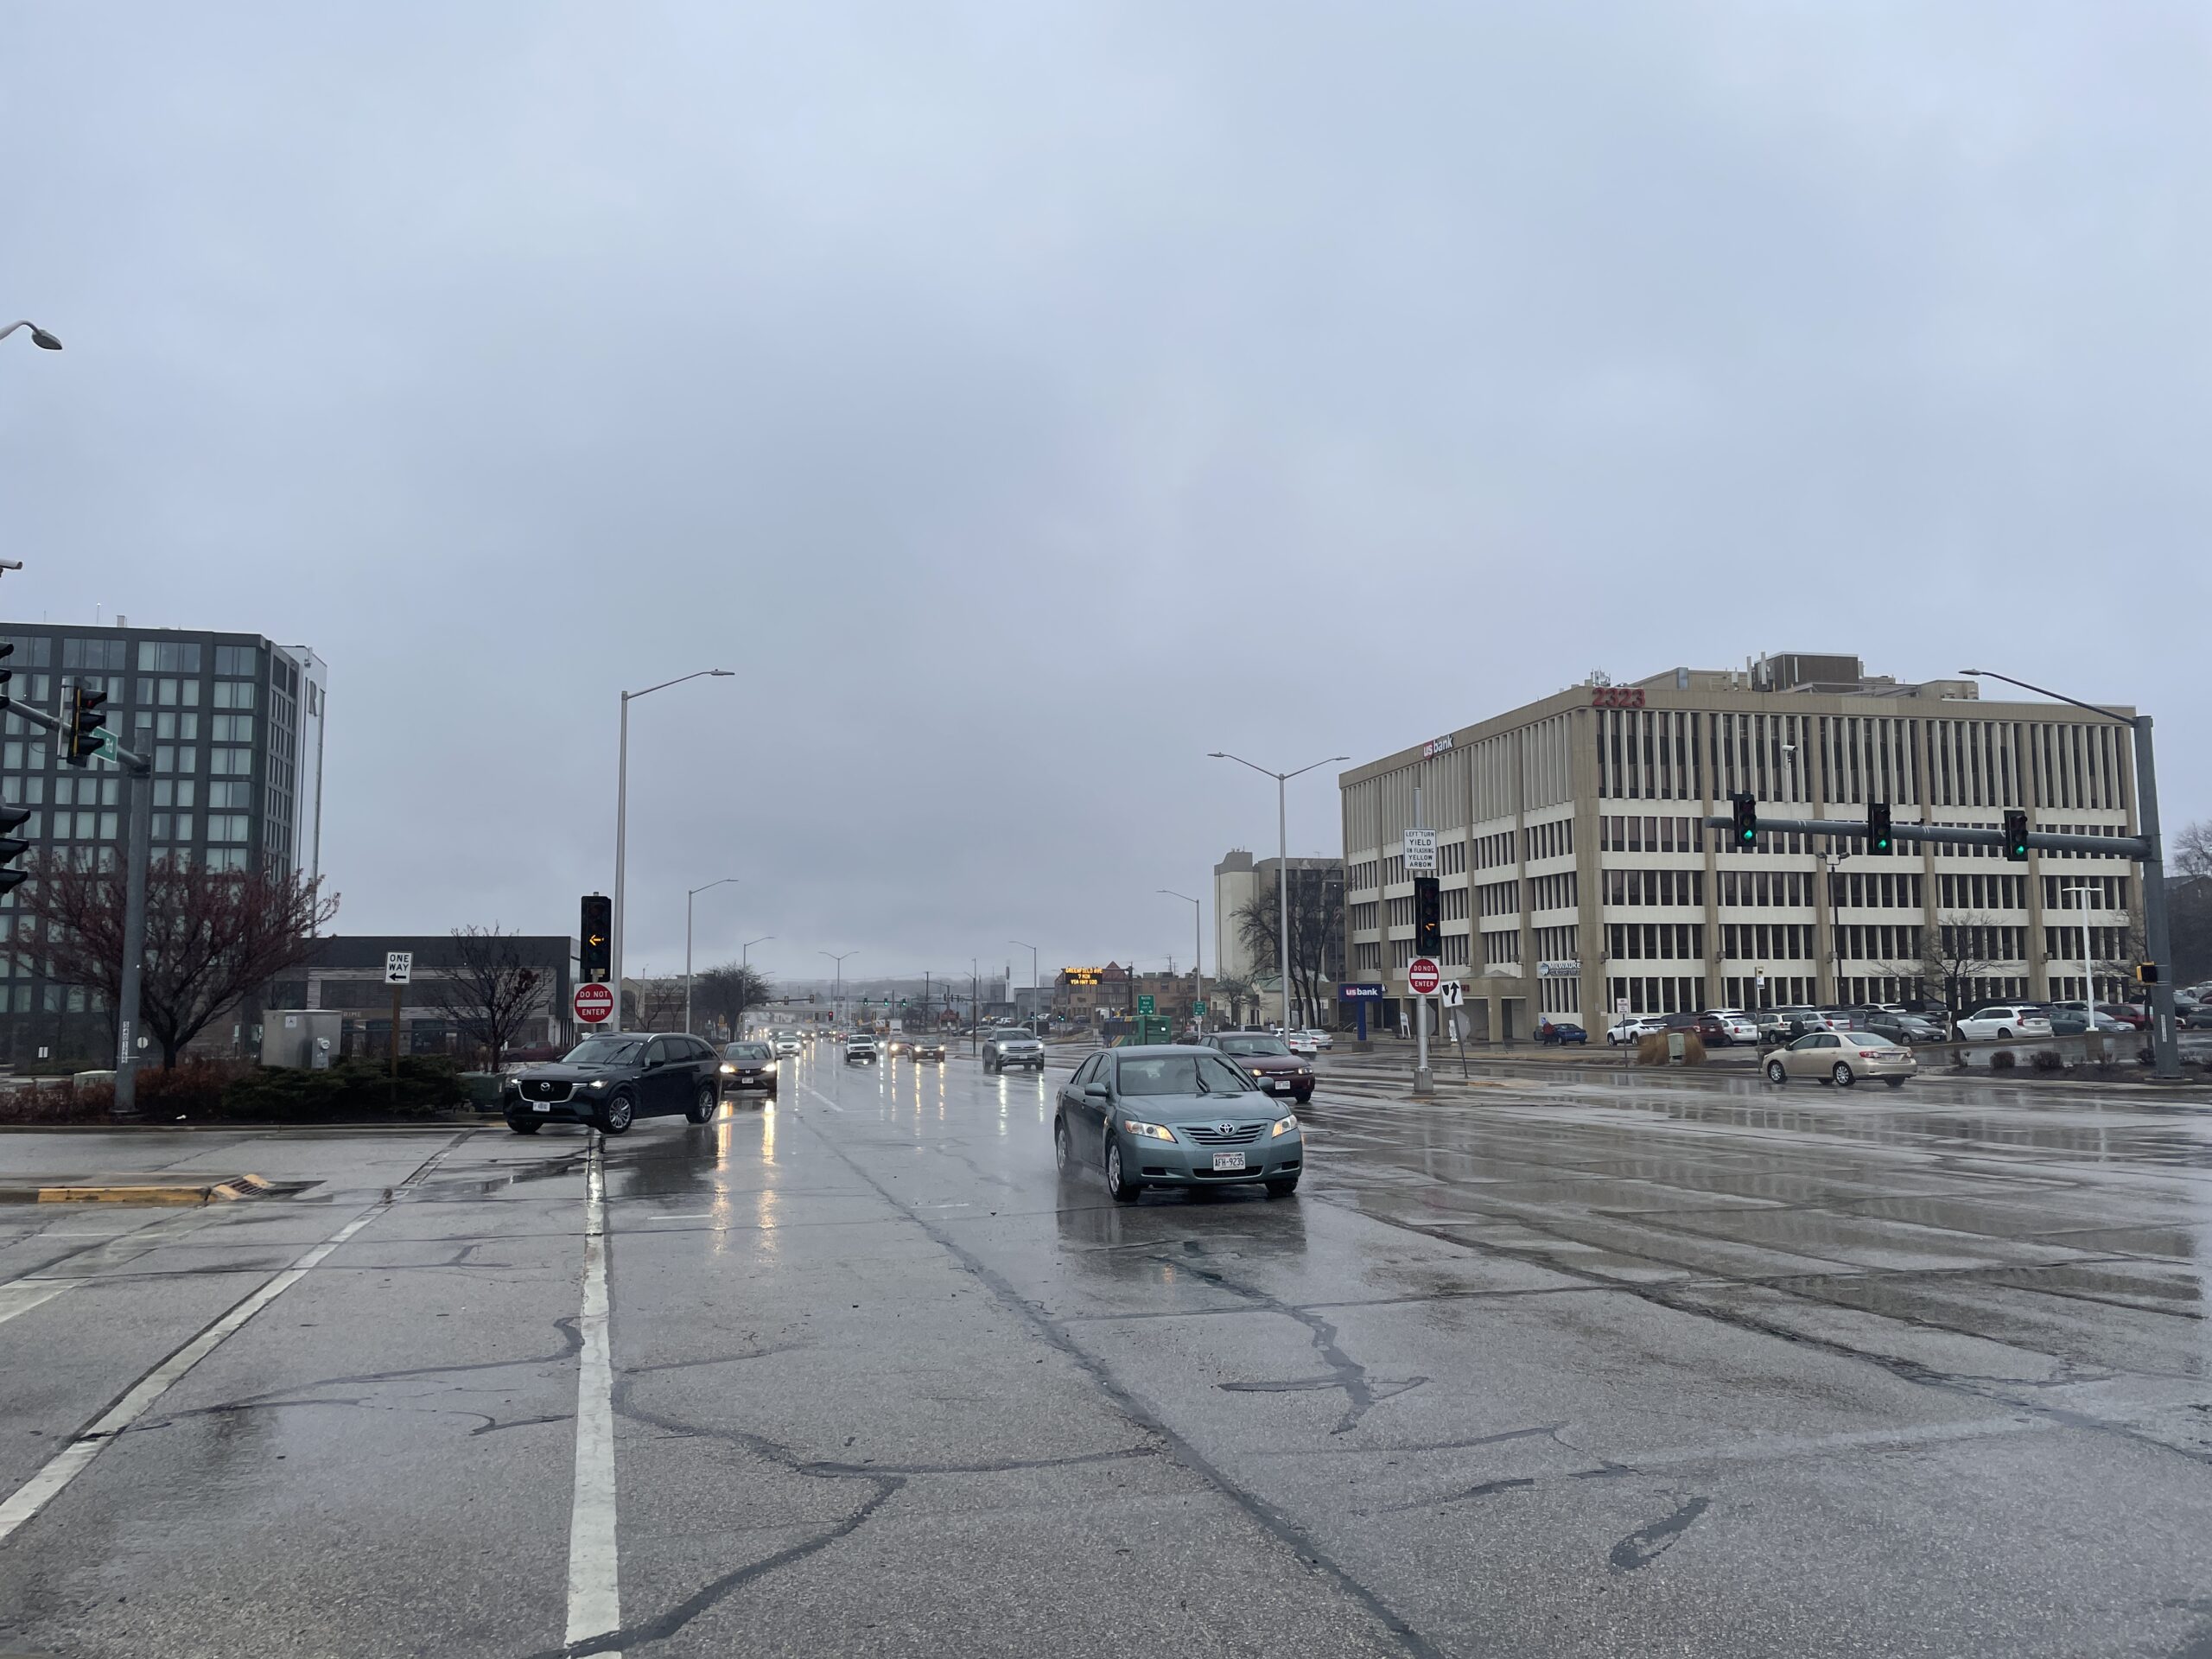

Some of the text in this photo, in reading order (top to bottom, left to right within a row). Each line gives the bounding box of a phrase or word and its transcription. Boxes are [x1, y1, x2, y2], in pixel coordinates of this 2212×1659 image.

[308, 680, 318, 716] R
[1592, 687, 1645, 707] 2323
[1215, 1158, 1244, 1166] AFH-9235
